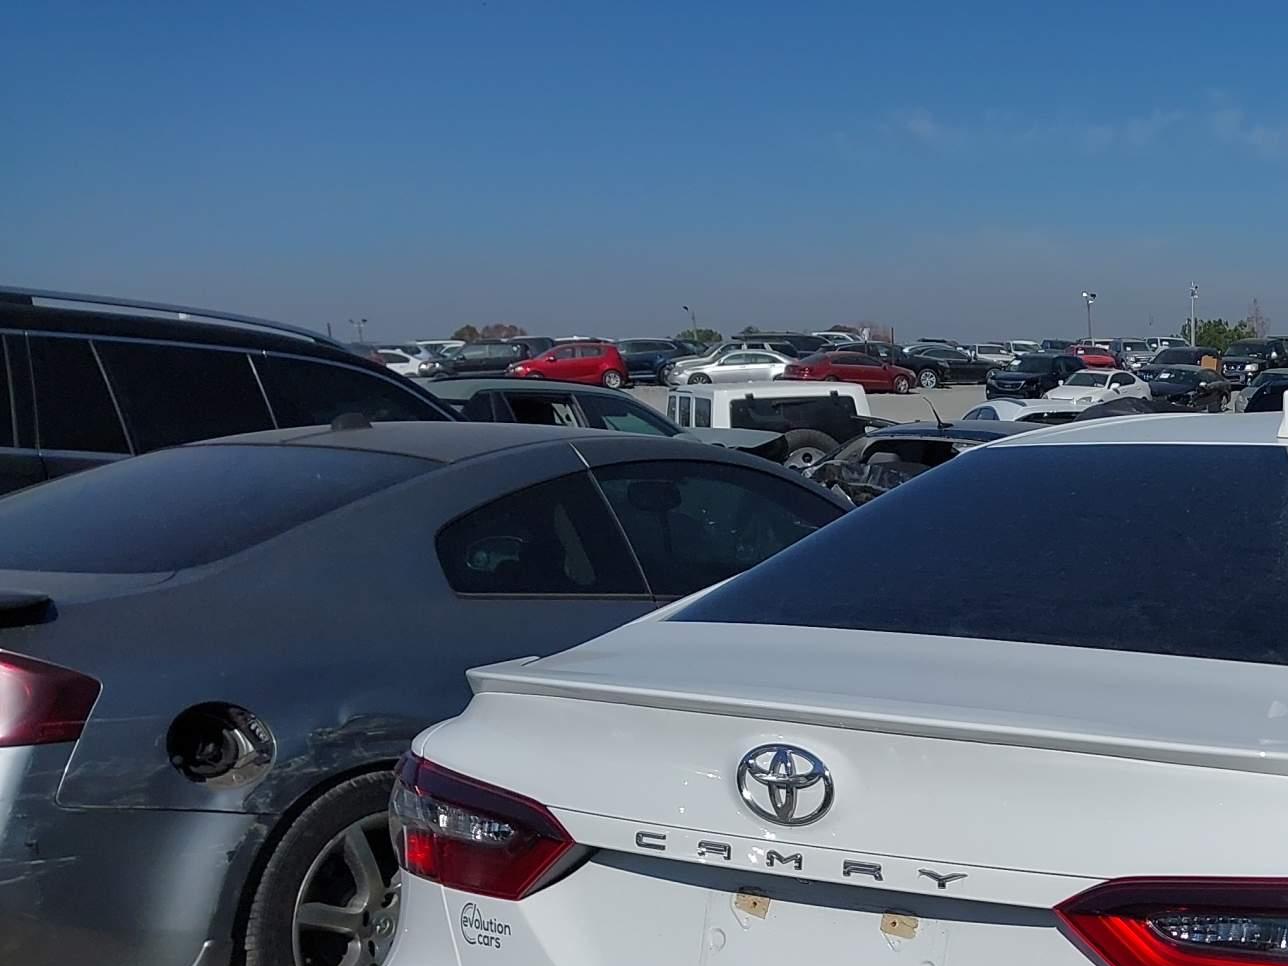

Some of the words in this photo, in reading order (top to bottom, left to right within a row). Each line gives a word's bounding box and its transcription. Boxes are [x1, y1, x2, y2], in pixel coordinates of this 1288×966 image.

[635, 830, 969, 890] CAMRY
[462, 903, 512, 936] evolution
[477, 933, 501, 949] cars
